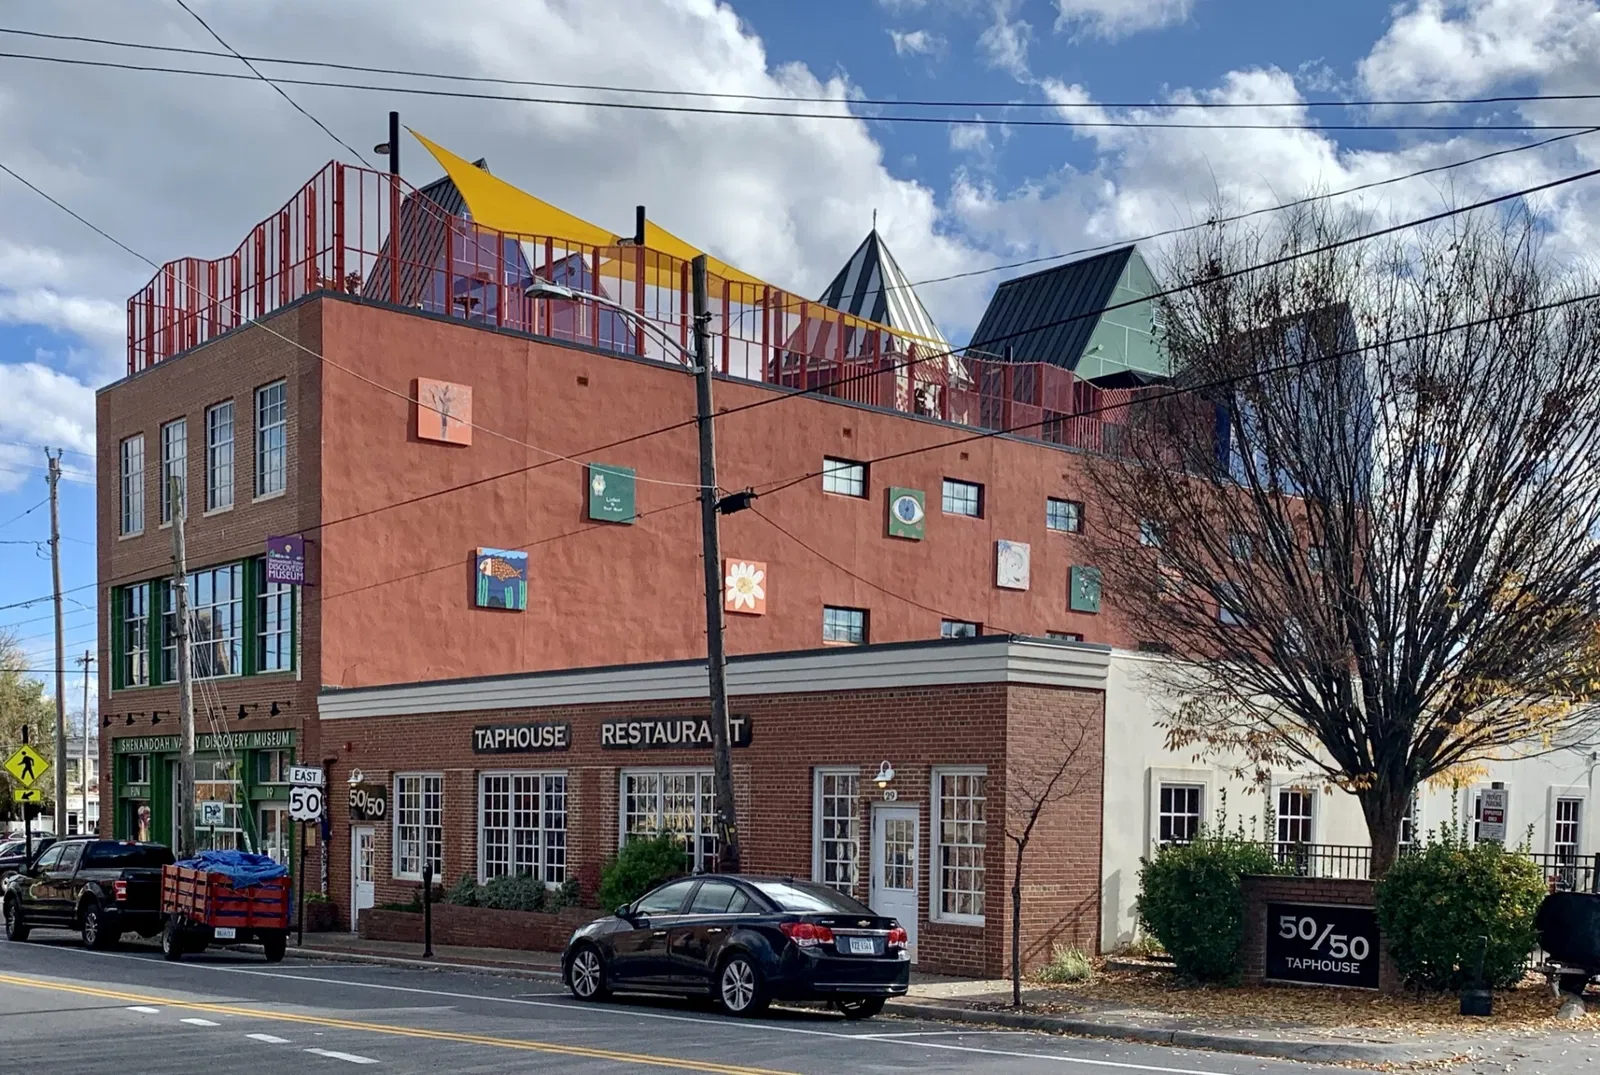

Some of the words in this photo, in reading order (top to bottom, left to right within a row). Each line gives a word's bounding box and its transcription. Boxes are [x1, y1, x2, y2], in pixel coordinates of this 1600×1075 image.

[269, 562, 303, 572] DISCOVERY
[269, 570, 303, 580] MUSEUM
[122, 738, 170, 751] SHENANDOAH
[204, 733, 249, 748] DISCOVERY
[254, 731, 290, 746] MUSEUM
[474, 725, 567, 749] TAPHOUSE
[601, 718, 745, 745] RESTAURAT
[295, 770, 317, 781] EAST
[291, 793, 319, 813] 50
[349, 789, 385, 816] 50/50
[885, 791, 895, 800] 29
[1278, 915, 1370, 960] 50/50
[1285, 956, 1361, 974] TAPHOUSE
